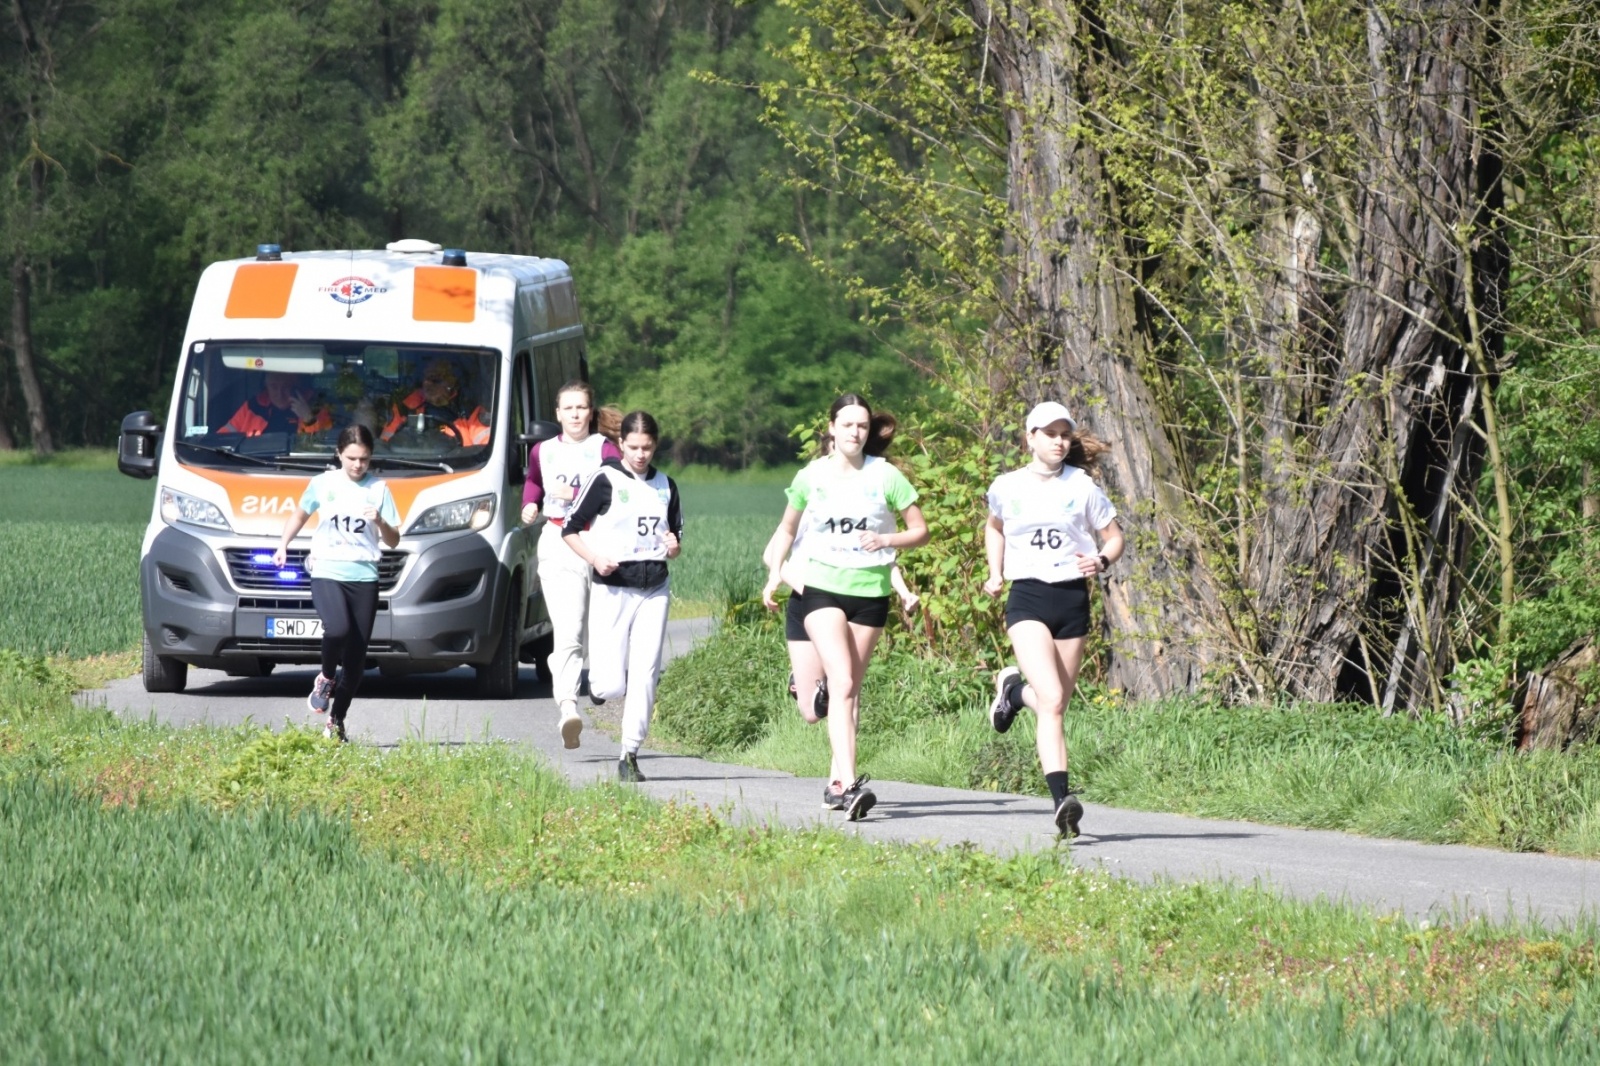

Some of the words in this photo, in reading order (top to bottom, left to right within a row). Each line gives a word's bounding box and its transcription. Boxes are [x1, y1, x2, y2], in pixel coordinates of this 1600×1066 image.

[330, 514, 367, 533] 112
[638, 516, 661, 536] 57
[1030, 528, 1062, 550] 46
[276, 620, 306, 636] SWD
